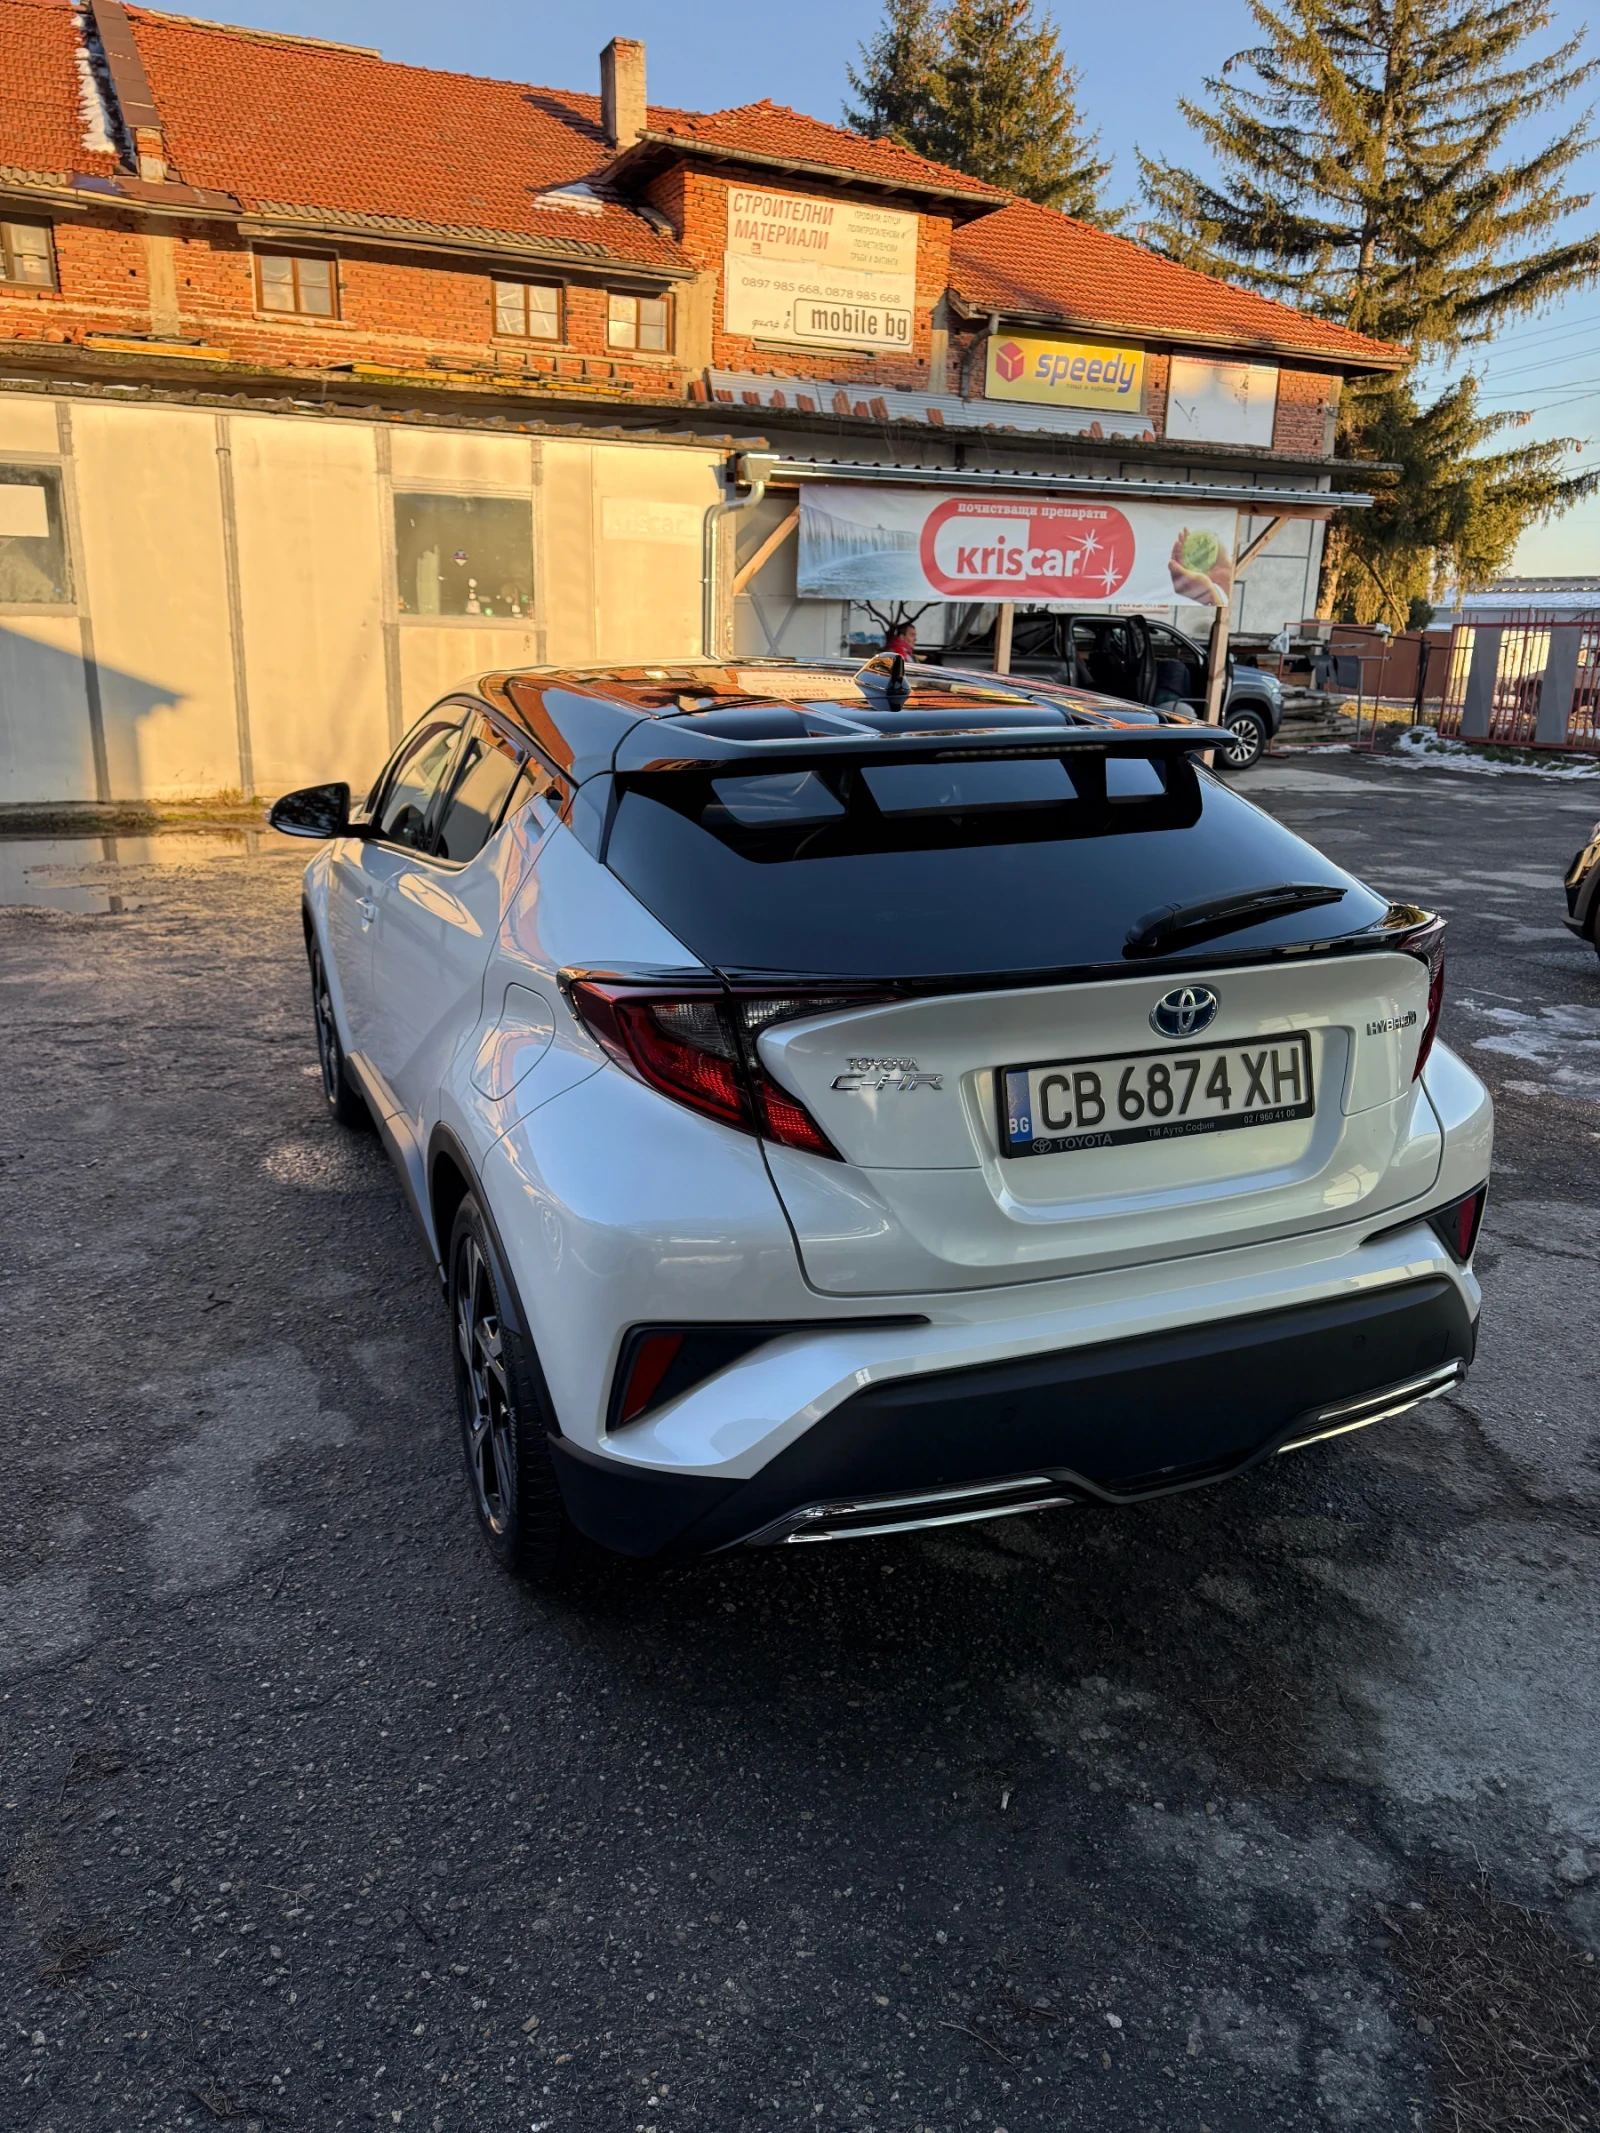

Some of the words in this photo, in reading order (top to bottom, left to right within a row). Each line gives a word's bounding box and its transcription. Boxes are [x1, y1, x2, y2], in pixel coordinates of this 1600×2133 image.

[733, 193, 834, 226] СТРОИТЕЛНИ
[734, 219, 829, 250] МАТЕРИАЛИ
[741, 277, 770, 288] 0897
[773, 281, 795, 292] 985
[825, 287, 854, 299] 0878
[856, 291, 877, 302] 985
[879, 293, 900, 304] 668
[811, 308, 877, 336] mobile
[885, 312, 907, 341] bg
[1035, 353, 1136, 393] speedy
[958, 502, 1038, 517] почистващи
[1041, 506, 1108, 520] препарати
[846, 1057, 920, 1072] TOYOTA
[829, 1073, 944, 1091] C-HR
[1040, 1071, 1105, 1130] CB
[1118, 1056, 1232, 1121] 6874
[1241, 1047, 1301, 1107] XH
[1008, 1117, 1029, 1135] BG
[1244, 1115, 1254, 1124] 02
[1259, 1112, 1274, 1121] 960
[1275, 1110, 1284, 1119] 41
[1163, 1125, 1184, 1137] Ауто
[1186, 1121, 1215, 1133] София
[1057, 1133, 1113, 1149] TOYOTA
